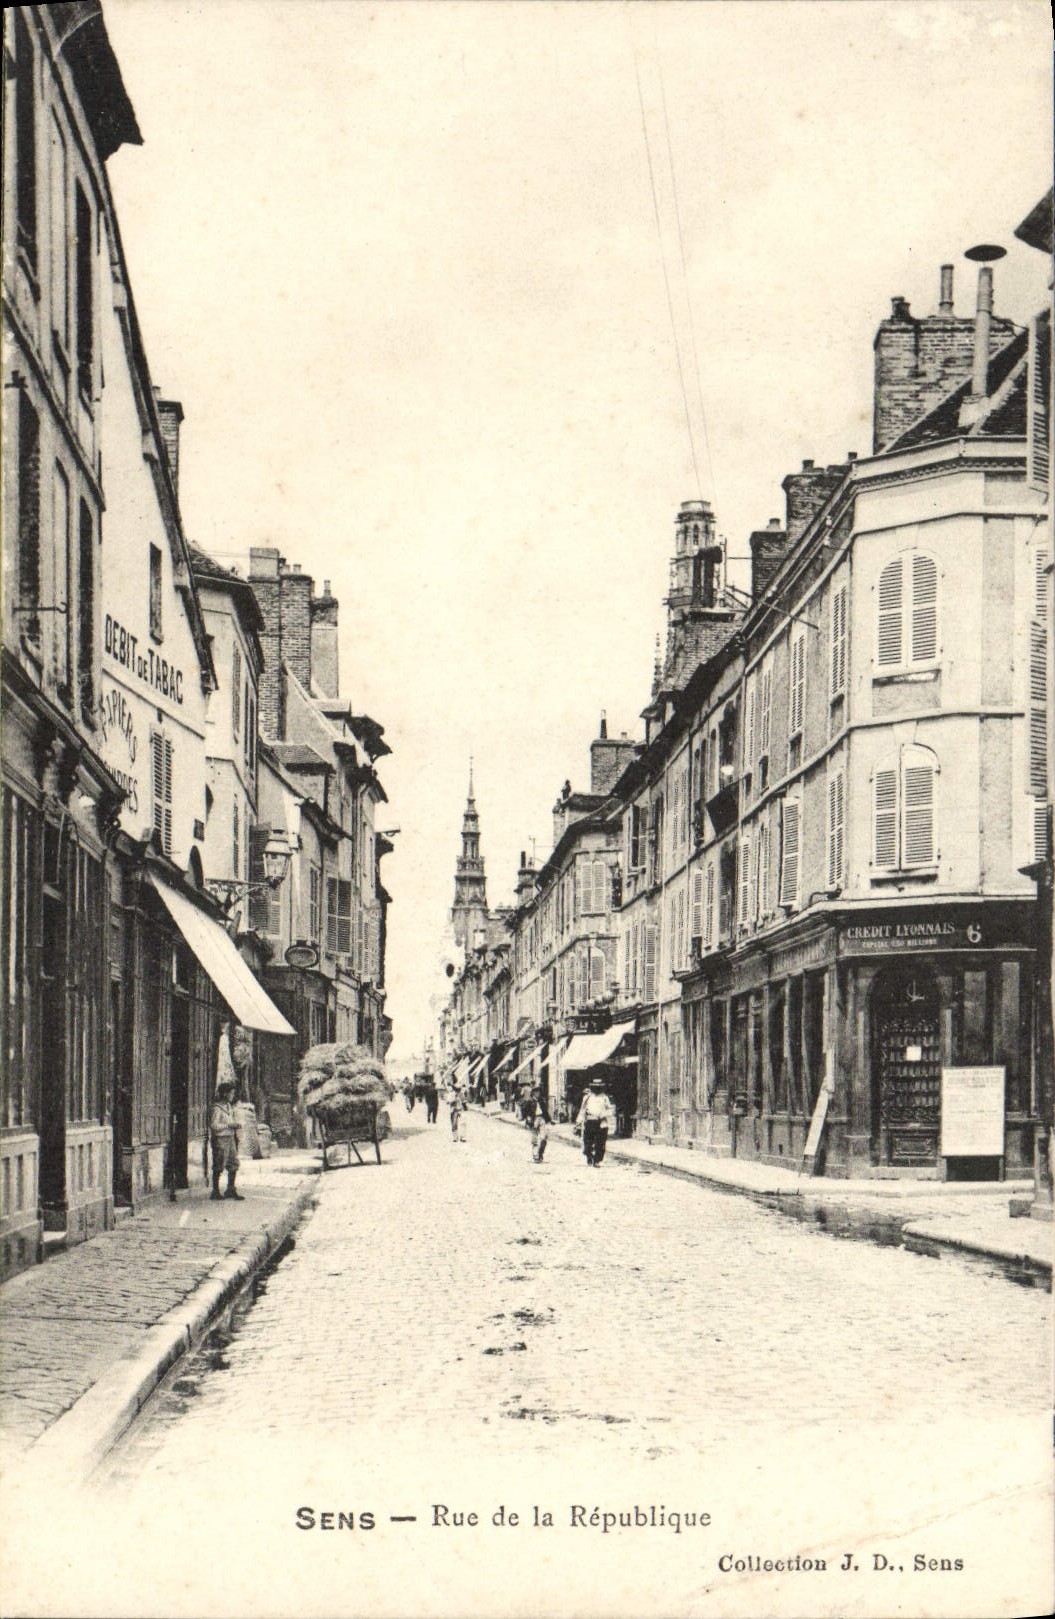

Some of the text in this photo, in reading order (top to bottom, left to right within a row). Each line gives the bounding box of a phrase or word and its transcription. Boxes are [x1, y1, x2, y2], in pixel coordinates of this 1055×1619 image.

[105, 613, 184, 705] DEBIT DE TABAC
[846, 924, 893, 940] CREDIT
[895, 921, 956, 937] LYONNAIS
